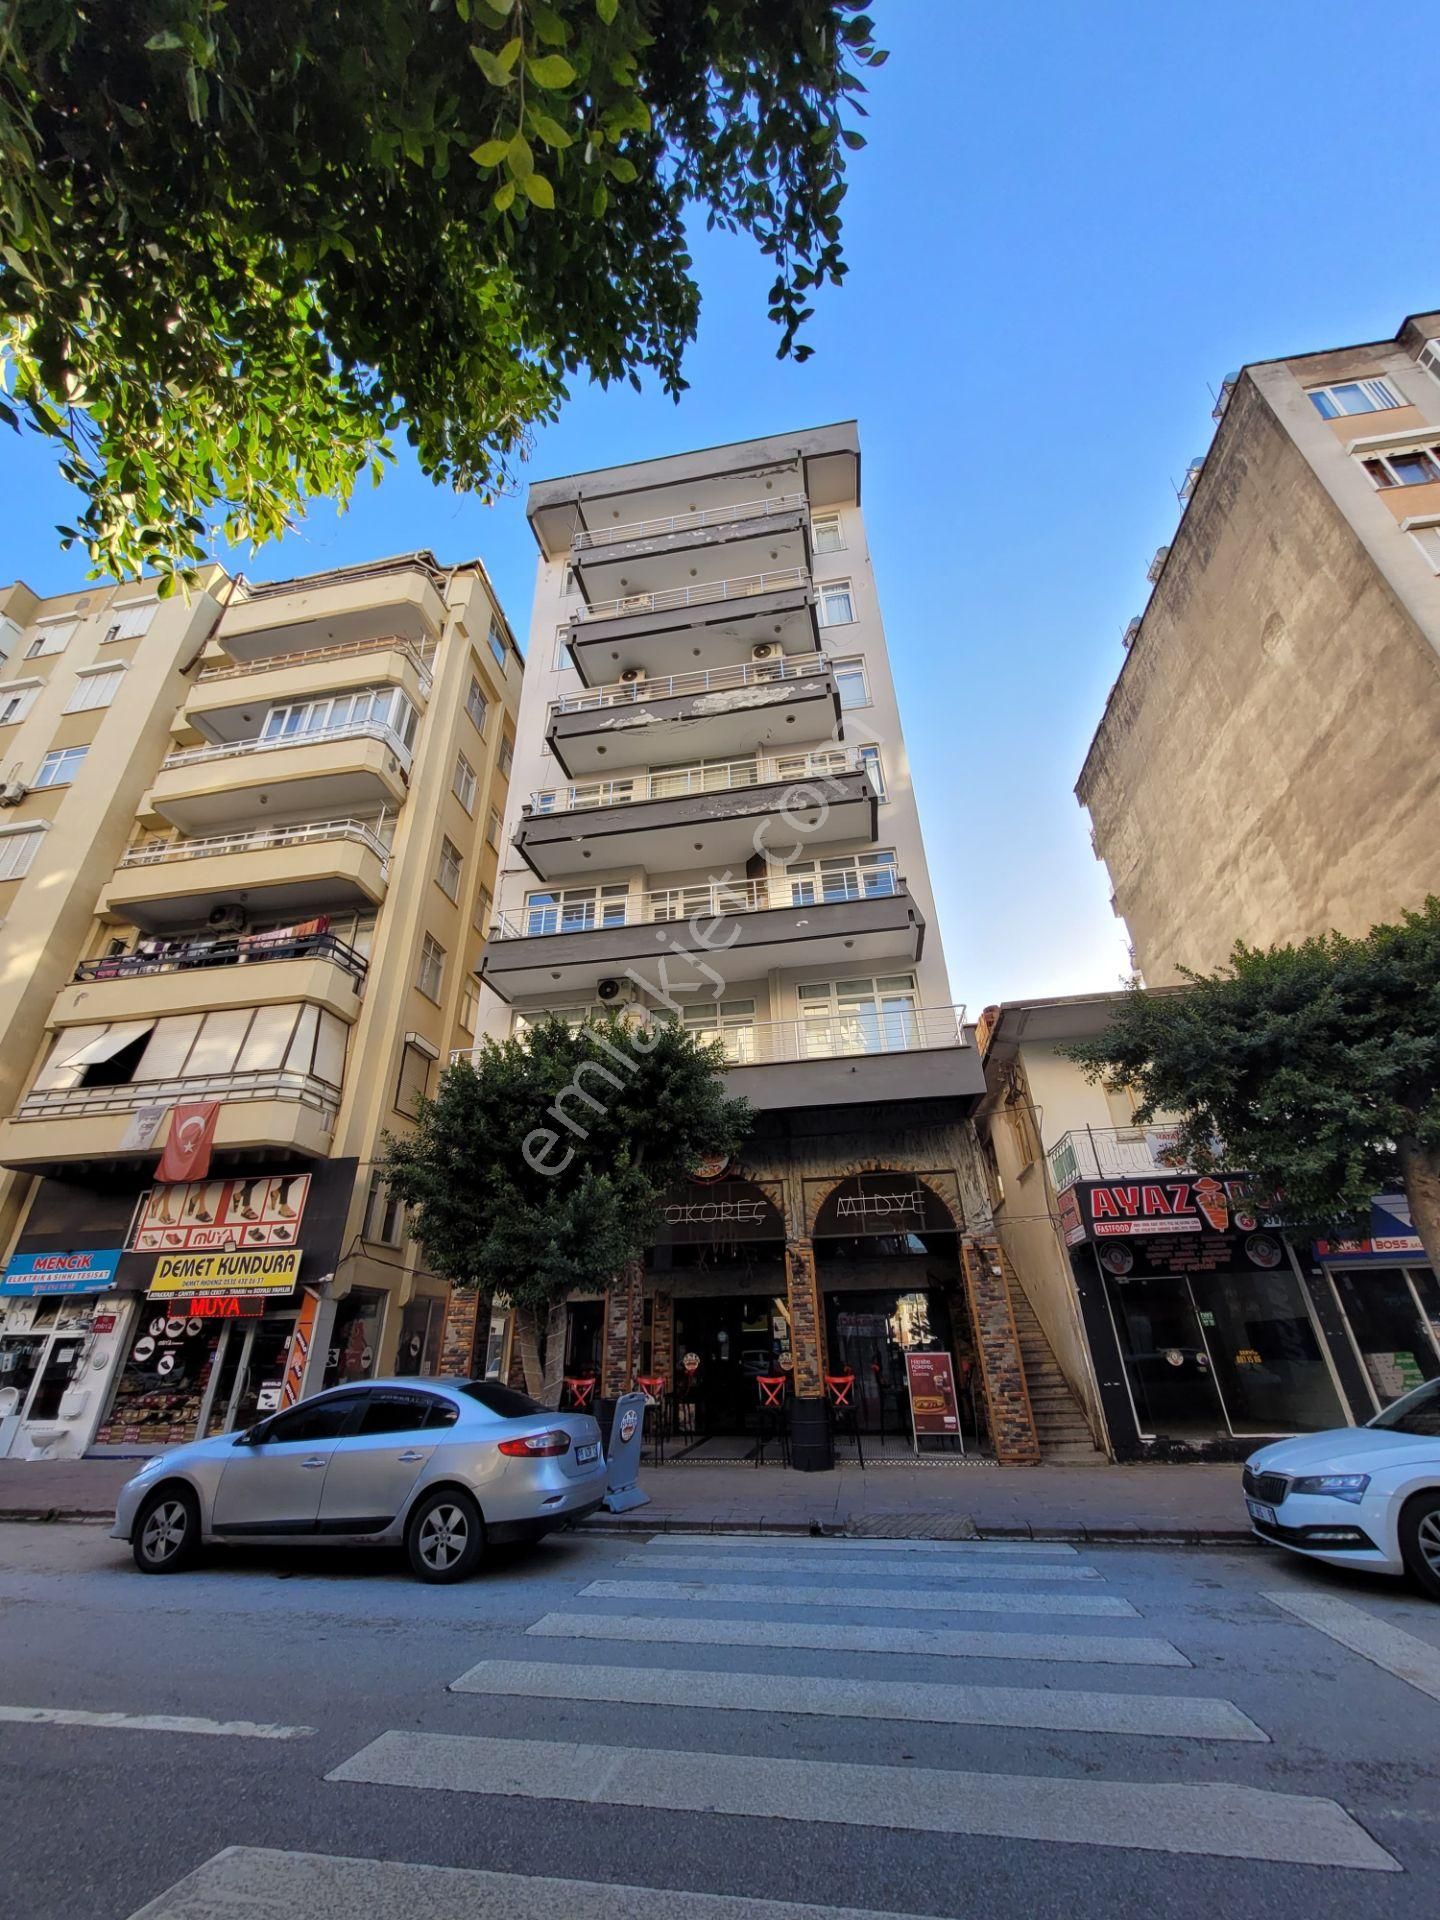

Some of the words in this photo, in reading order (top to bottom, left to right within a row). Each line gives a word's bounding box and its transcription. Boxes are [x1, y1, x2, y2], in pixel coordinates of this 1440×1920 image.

[1091, 1184, 1196, 1217] AYAZ
[1096, 1224, 1130, 1233] FASTFOOD
[1375, 1240, 1409, 1249] BOSS
[159, 1257, 215, 1279] DEMET
[216, 1253, 296, 1276] KUNDURA
[190, 1298, 240, 1316] MUYA
